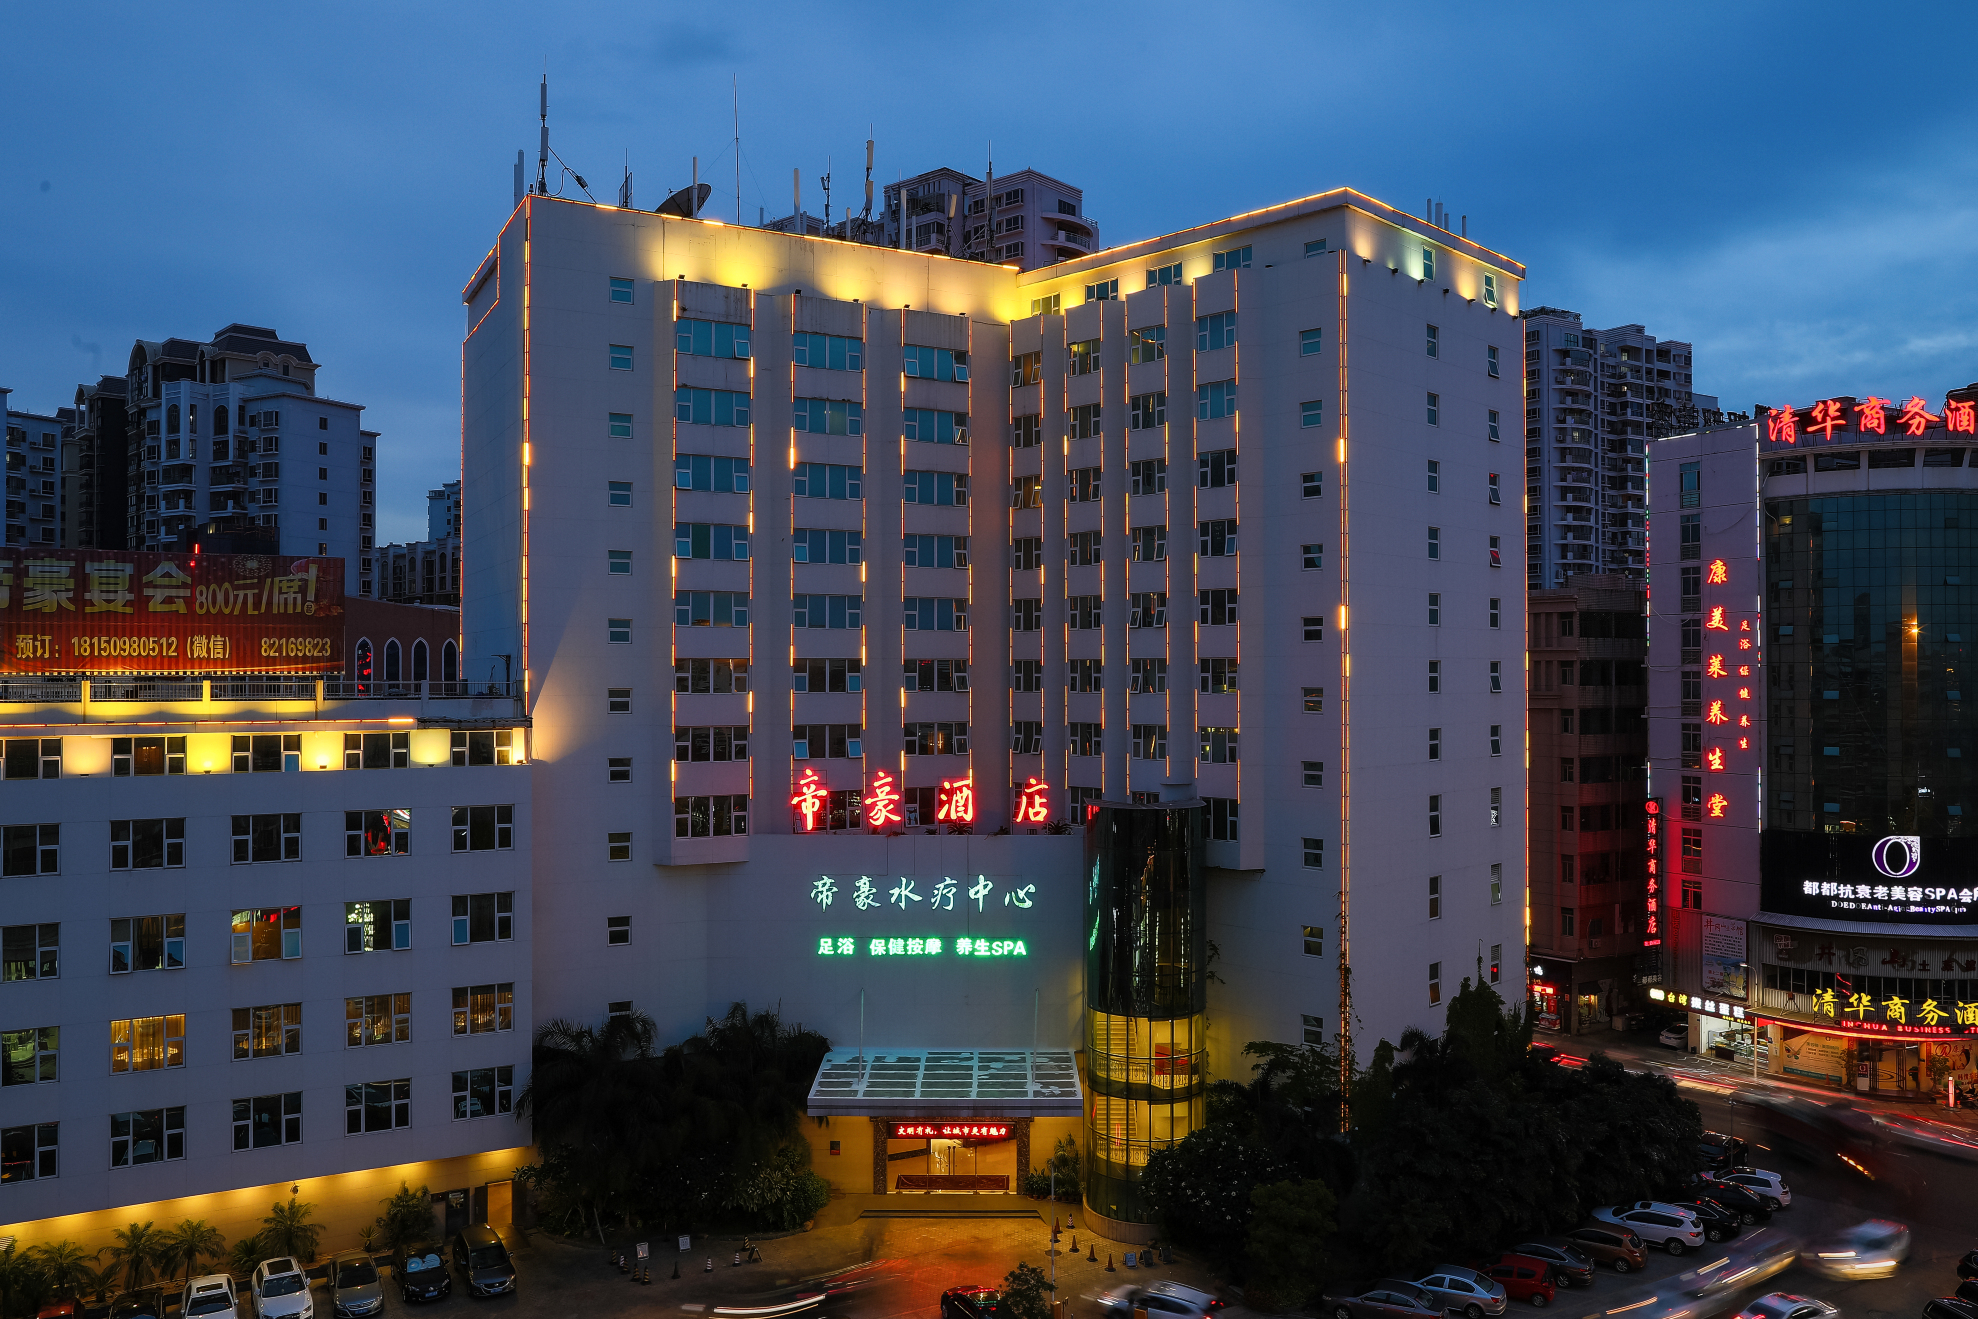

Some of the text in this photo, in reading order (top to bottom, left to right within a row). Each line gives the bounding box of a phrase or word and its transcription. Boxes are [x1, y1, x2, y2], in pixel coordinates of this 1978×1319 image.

[1768, 395, 1976, 443] 清华商务酒
[0, 558, 192, 614] 豪宴会
[71, 636, 178, 657] 18150980512
[260, 637, 331, 657] 82169823
[791, 768, 1049, 831] 帝豪酒店
[810, 875, 1036, 913] 帝豪水疗中心
[818, 937, 1027, 957] 足浴 保健按摩 养生SPA
